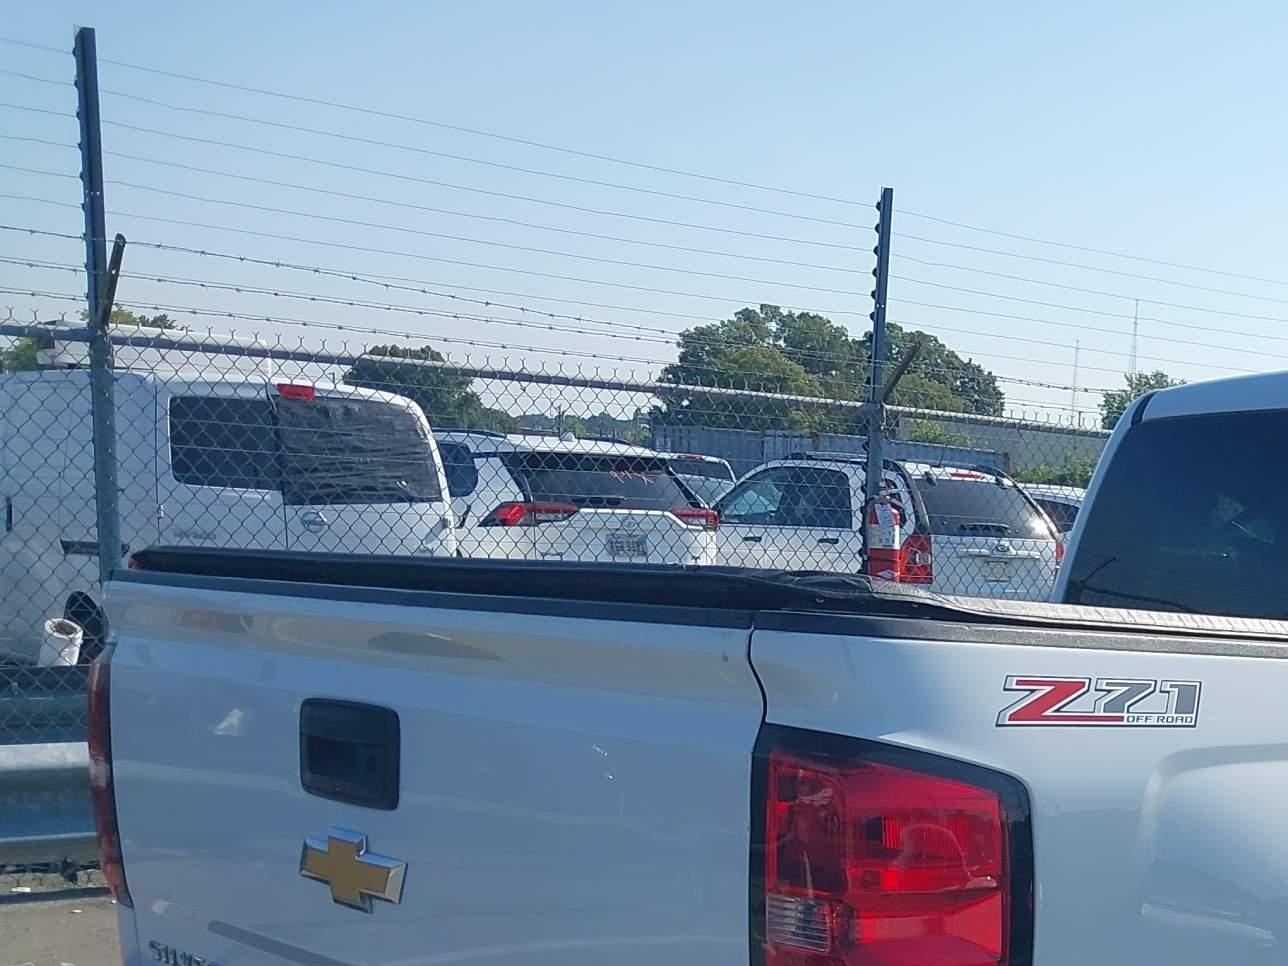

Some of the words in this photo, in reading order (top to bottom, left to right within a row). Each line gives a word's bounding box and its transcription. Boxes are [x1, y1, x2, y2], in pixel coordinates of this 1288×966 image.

[995, 674, 1202, 728] Z71
[1126, 714, 1153, 724] OFF
[1156, 715, 1193, 724] ROAD
